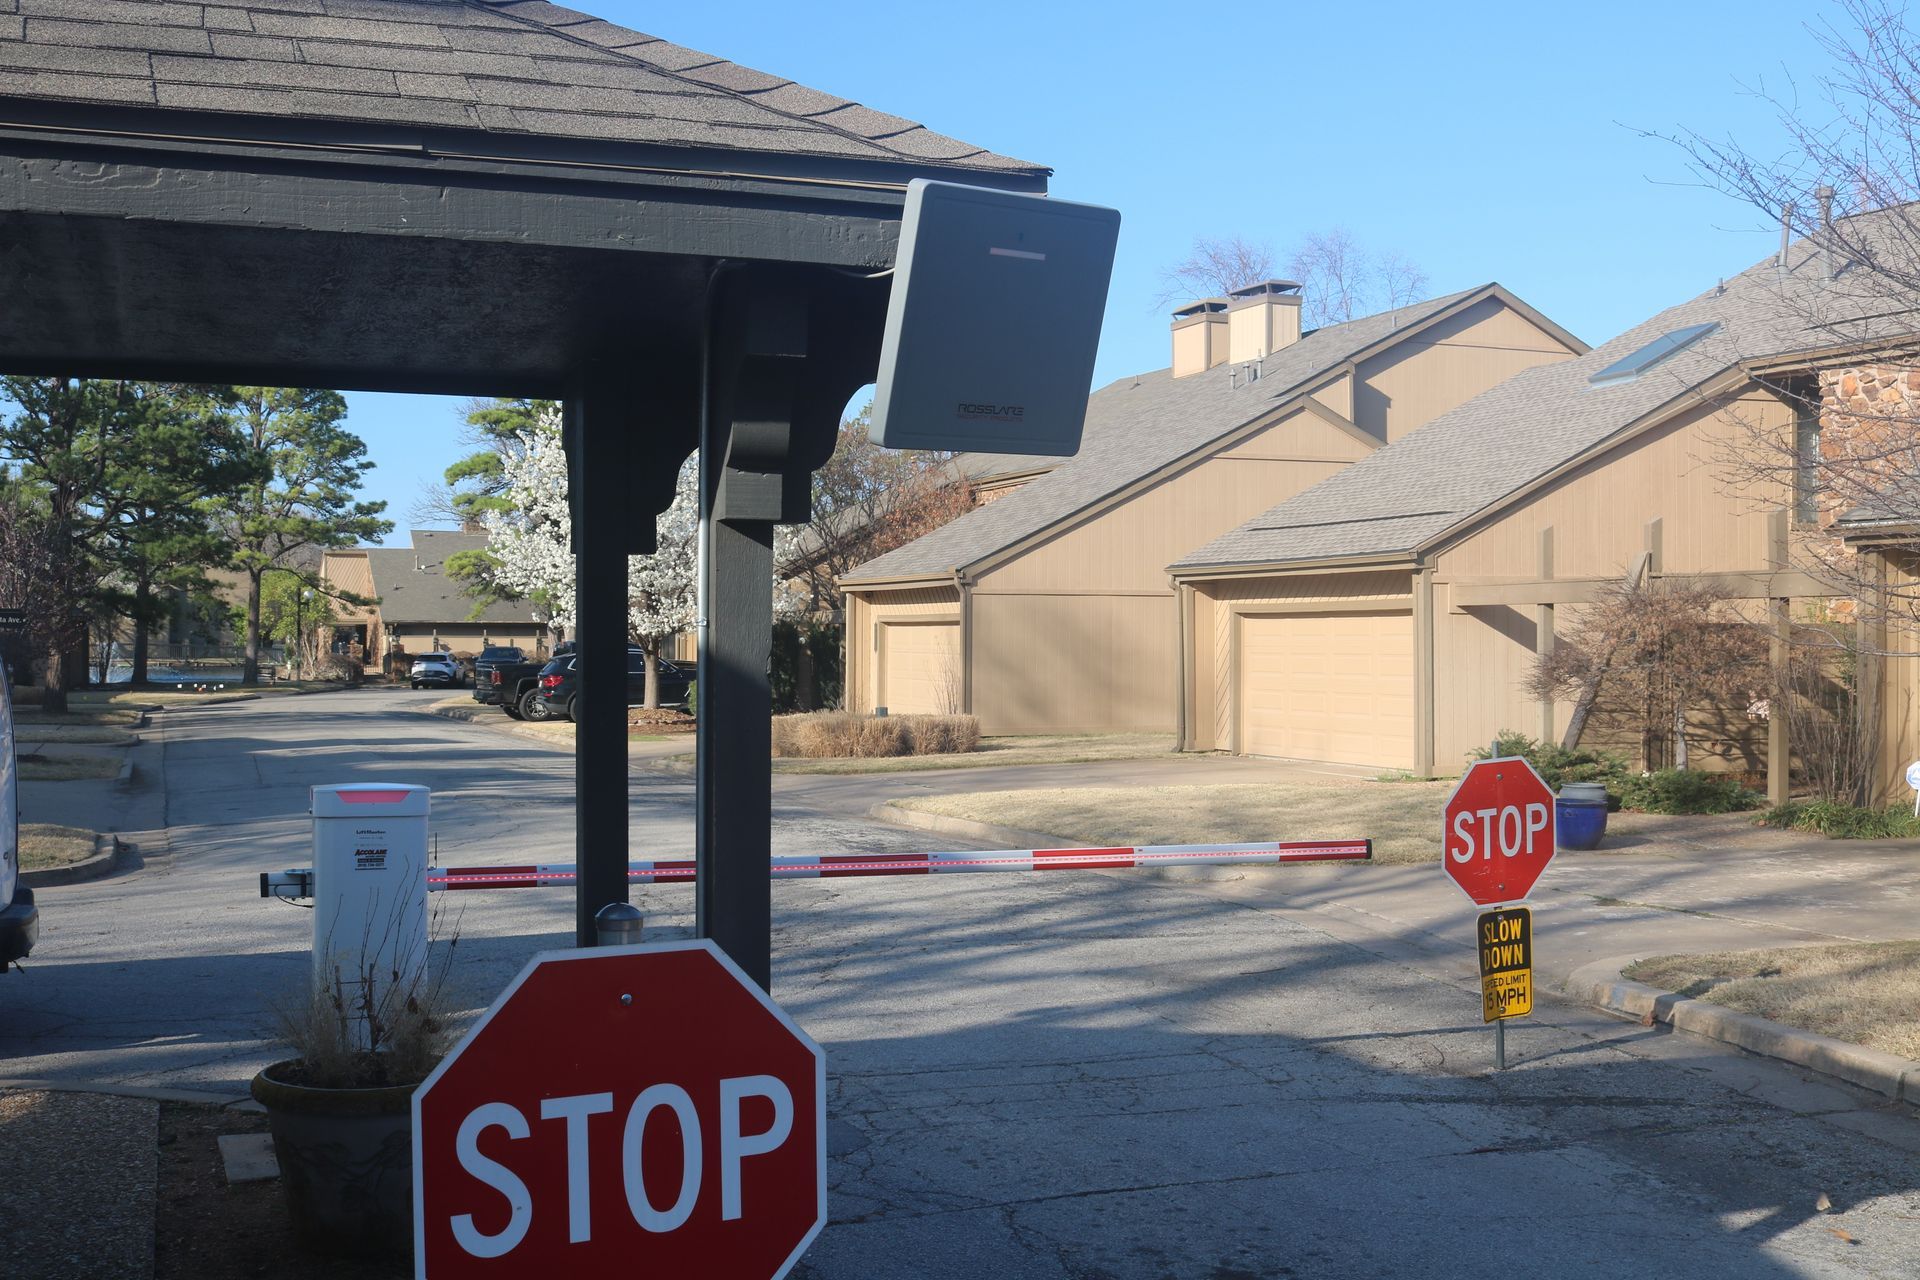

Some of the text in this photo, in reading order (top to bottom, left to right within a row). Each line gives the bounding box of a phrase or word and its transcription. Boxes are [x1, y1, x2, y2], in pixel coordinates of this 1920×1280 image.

[957, 403, 1024, 416] ROSSLARE
[1451, 802, 1548, 864] STOP
[1484, 918, 1522, 945] SLOW
[1484, 943, 1524, 971] DOWN
[1505, 973, 1527, 985] LIMIT
[1496, 986, 1527, 1008] MPH
[450, 1074, 795, 1259] STOP
